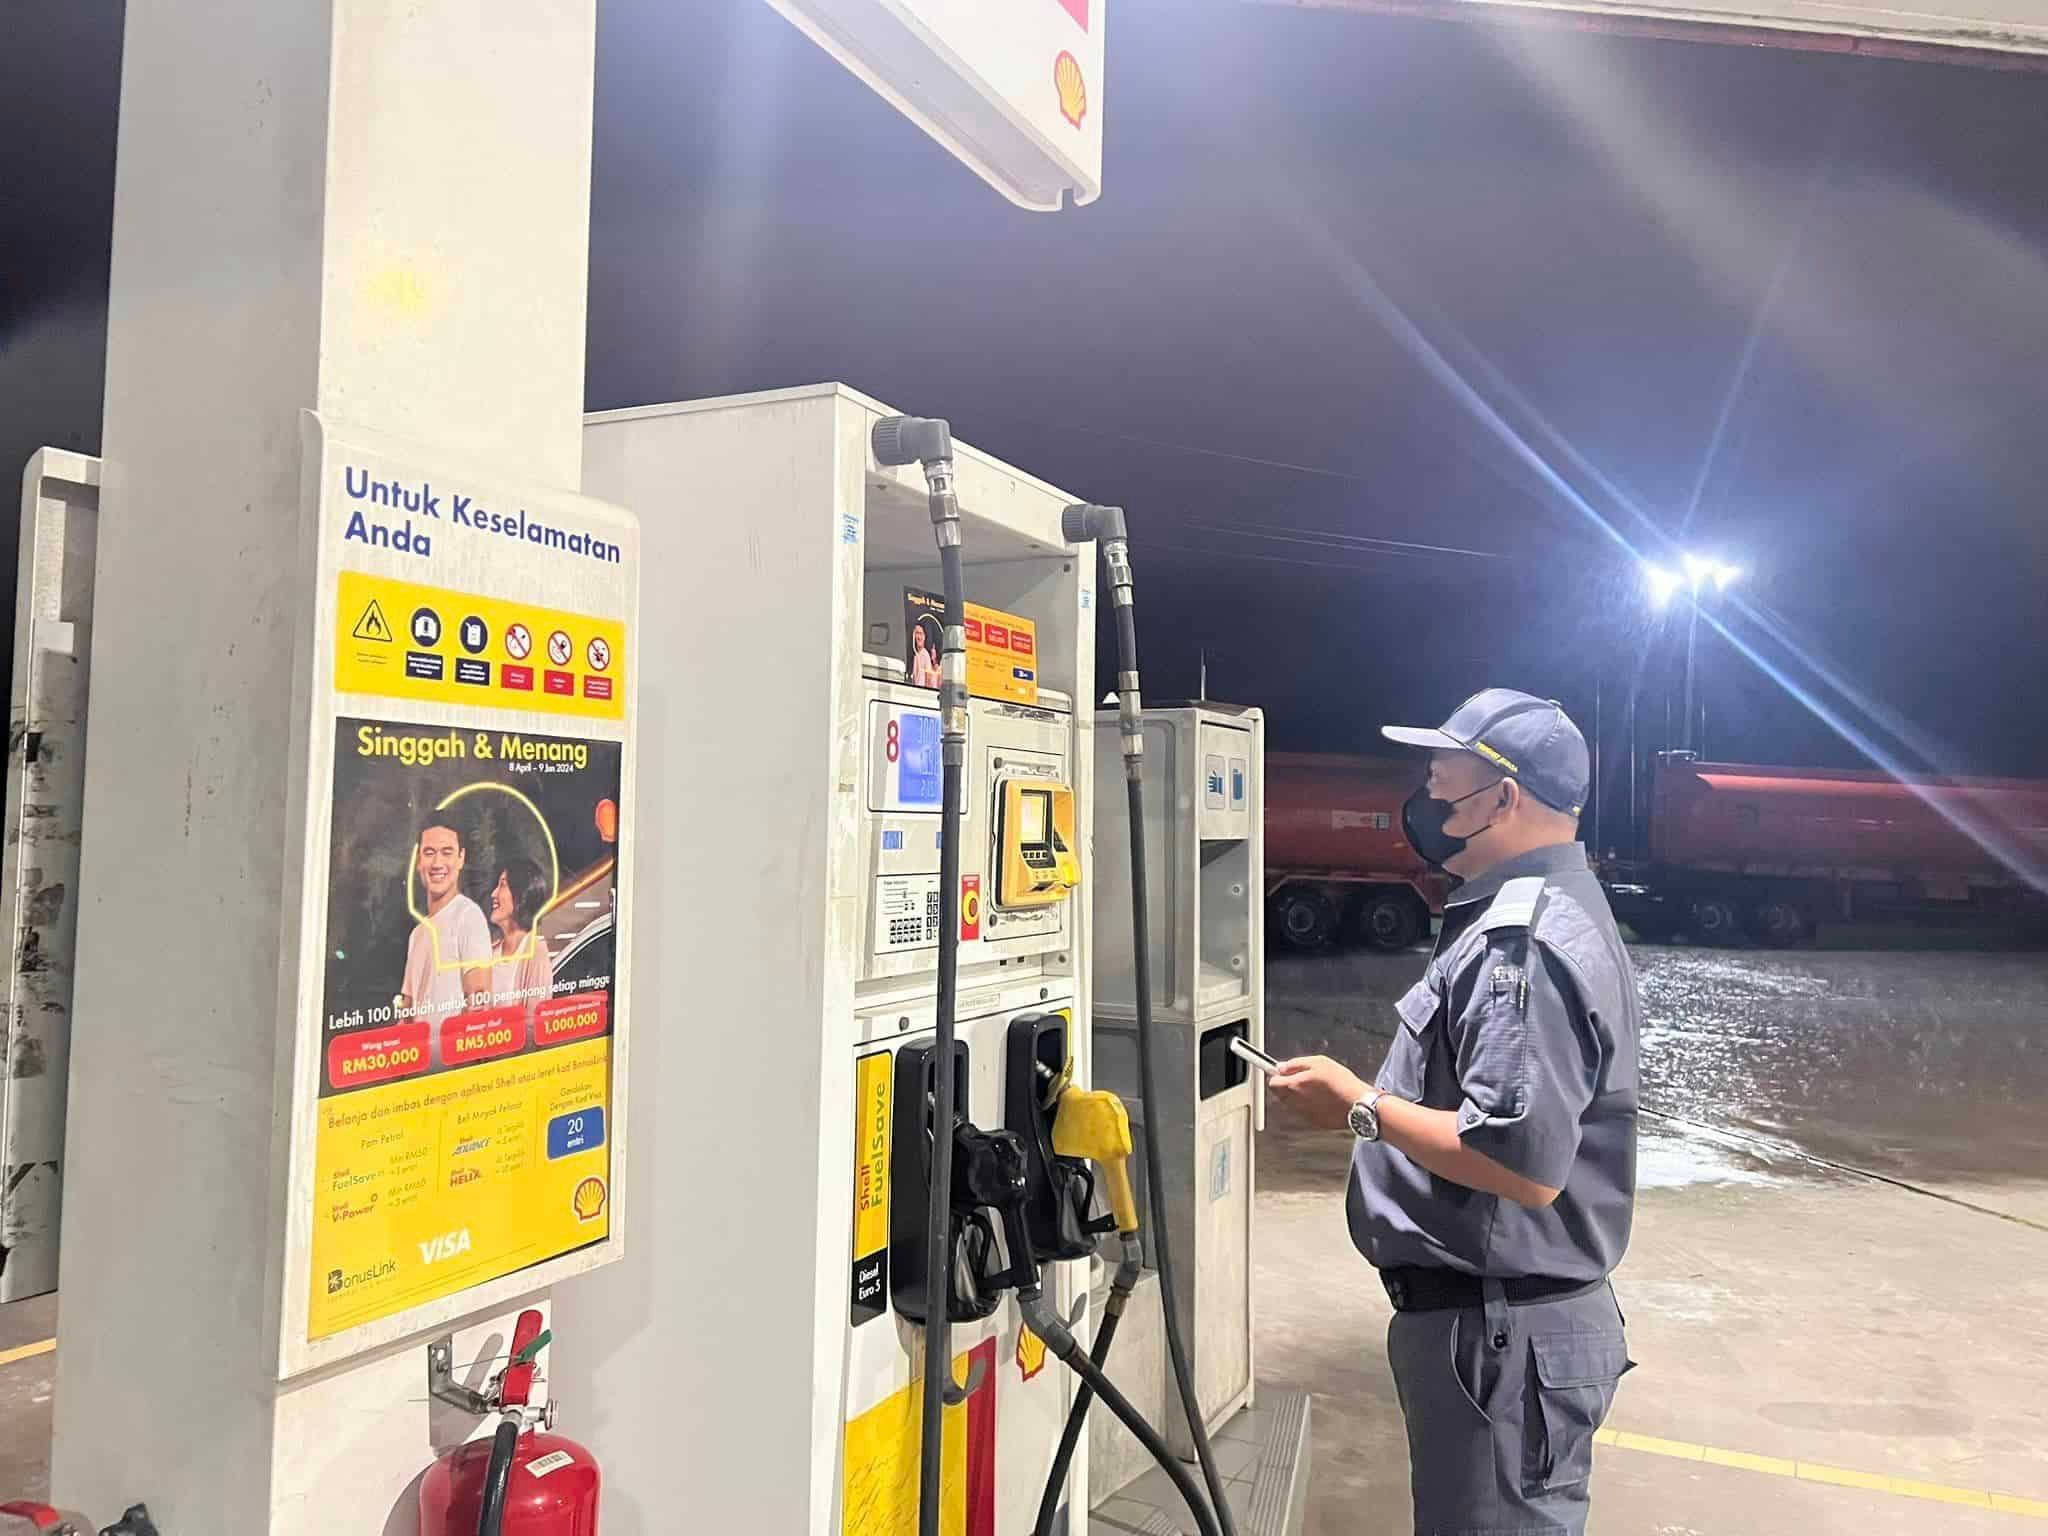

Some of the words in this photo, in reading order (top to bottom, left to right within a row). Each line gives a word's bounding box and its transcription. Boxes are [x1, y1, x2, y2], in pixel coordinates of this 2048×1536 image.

[345, 465, 441, 519] Untuk
[452, 493, 621, 564] Keselamatan
[344, 510, 432, 557] Anda
[357, 725, 466, 766] Singgah
[473, 733, 493, 760] &
[500, 734, 588, 769] Menang
[886, 719, 899, 763] 8
[516, 761, 531, 775] April
[556, 763, 575, 773] 2024
[328, 1009, 364, 1030] Lebih
[367, 1005, 392, 1023] 100
[394, 1000, 435, 1020] hadiah
[438, 992, 467, 1012] untuk
[469, 991, 491, 1007] 100
[493, 985, 547, 1006] pemenang
[550, 978, 577, 994] setiap
[544, 1010, 599, 1035] 1,000,000
[455, 1028, 513, 1053] RM5,000
[342, 1046, 420, 1075] RM30,000
[328, 1111, 368, 1129] Belanja
[370, 1106, 391, 1120] dan
[392, 1099, 421, 1114] imbas
[423, 1090, 458, 1106] dengan
[495, 1072, 516, 1089] Shell
[567, 1116, 584, 1136] 20
[871, 1080, 886, 1208] FuelSave
[449, 1169, 481, 1188] HELIX
[860, 1163, 870, 1212] Shell
[418, 1227, 471, 1265] VISA
[327, 1258, 396, 1295] BonusLink
[858, 1261, 879, 1285] Diesel
[858, 1284, 874, 1301] Euro
[874, 1282, 881, 1297] 5
